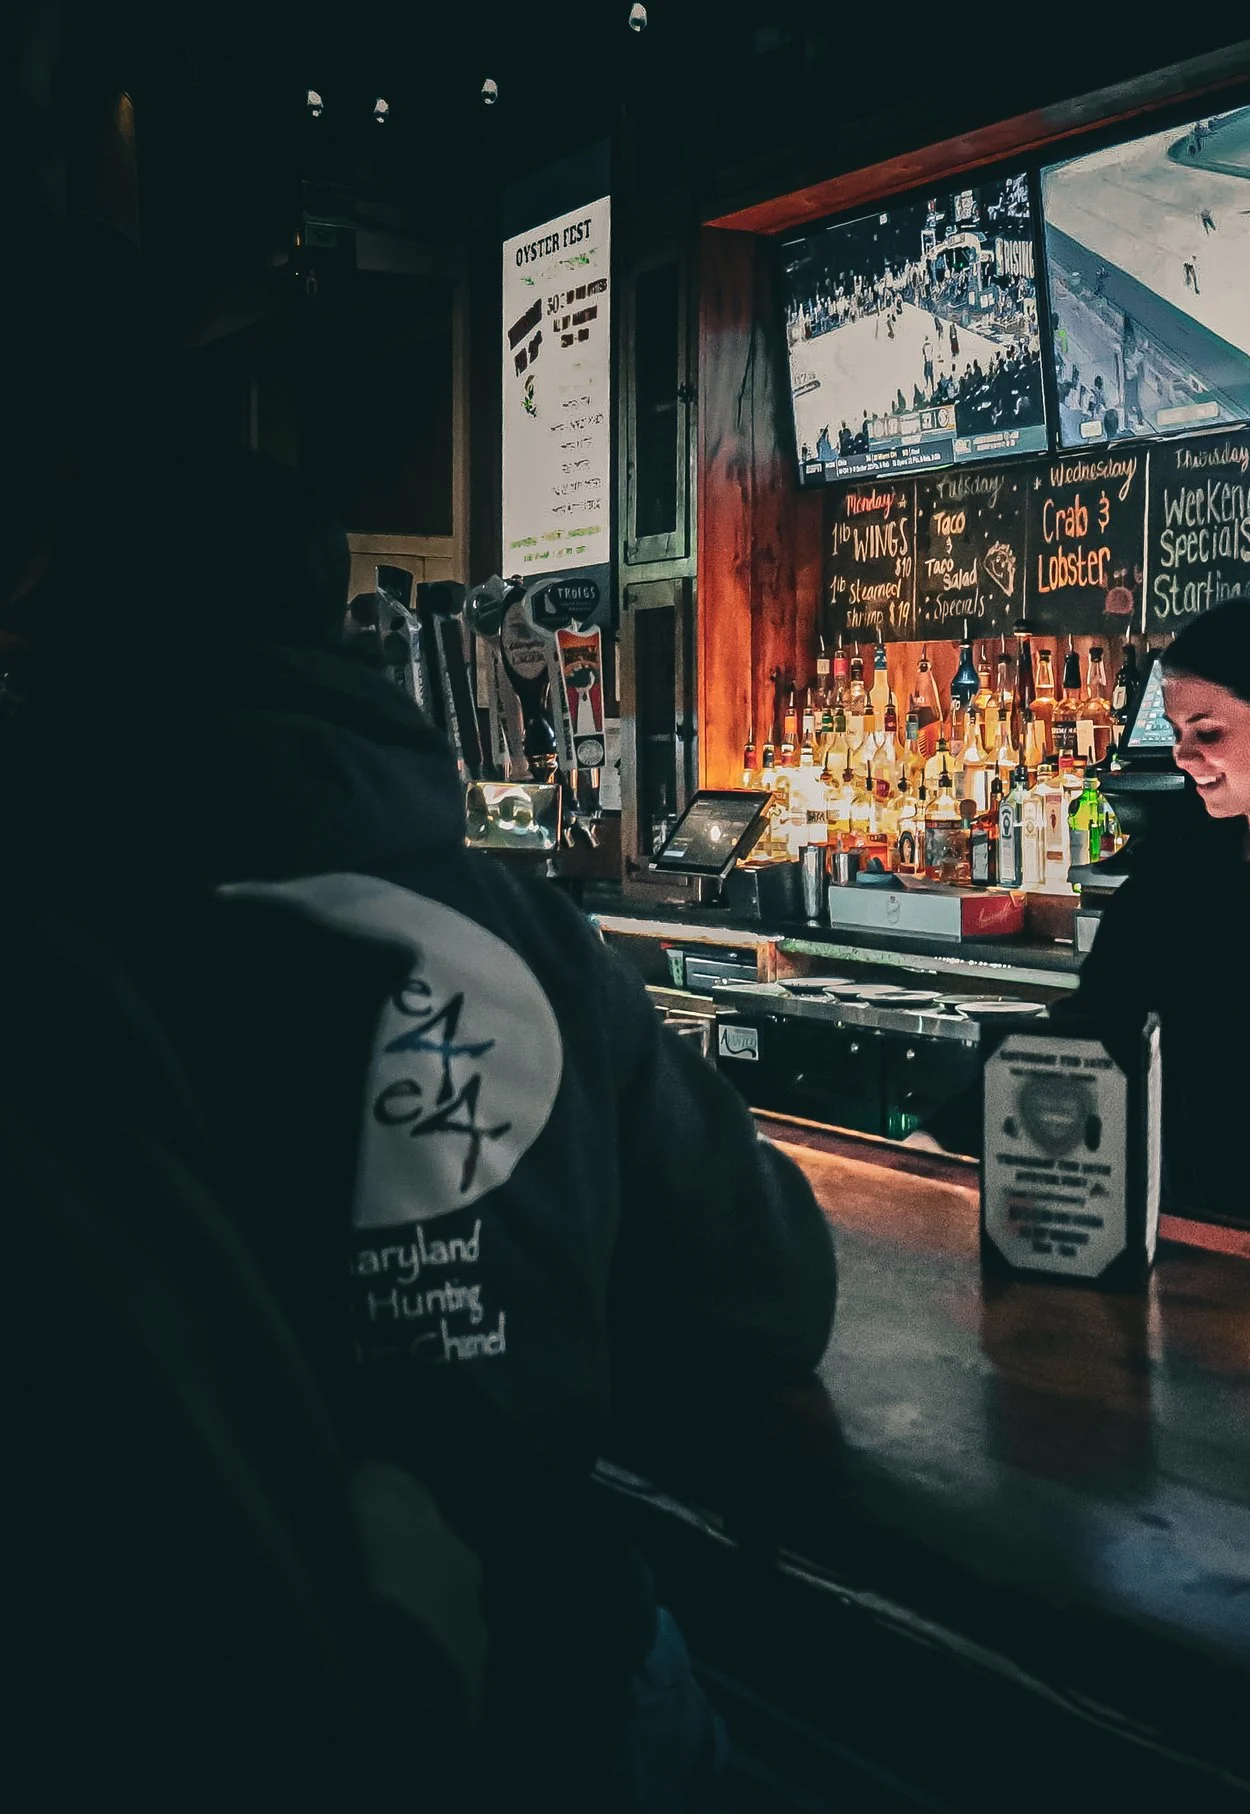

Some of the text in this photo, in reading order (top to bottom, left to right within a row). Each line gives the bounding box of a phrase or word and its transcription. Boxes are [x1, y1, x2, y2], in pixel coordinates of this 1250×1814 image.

[515, 232, 560, 267] OYSTER
[563, 218, 592, 248] FEST
[1050, 457, 1137, 501] Wednesday
[1175, 442, 1249, 473] Thursday
[847, 489, 897, 520] Monday
[936, 476, 1004, 508] Tuesday
[853, 517, 909, 562] WINGS
[934, 511, 966, 536] Taco
[1042, 493, 1088, 544] Crab
[925, 558, 955, 578] Taco
[1038, 545, 1111, 593] Lobster
[351, 1217, 482, 1285] aryland
